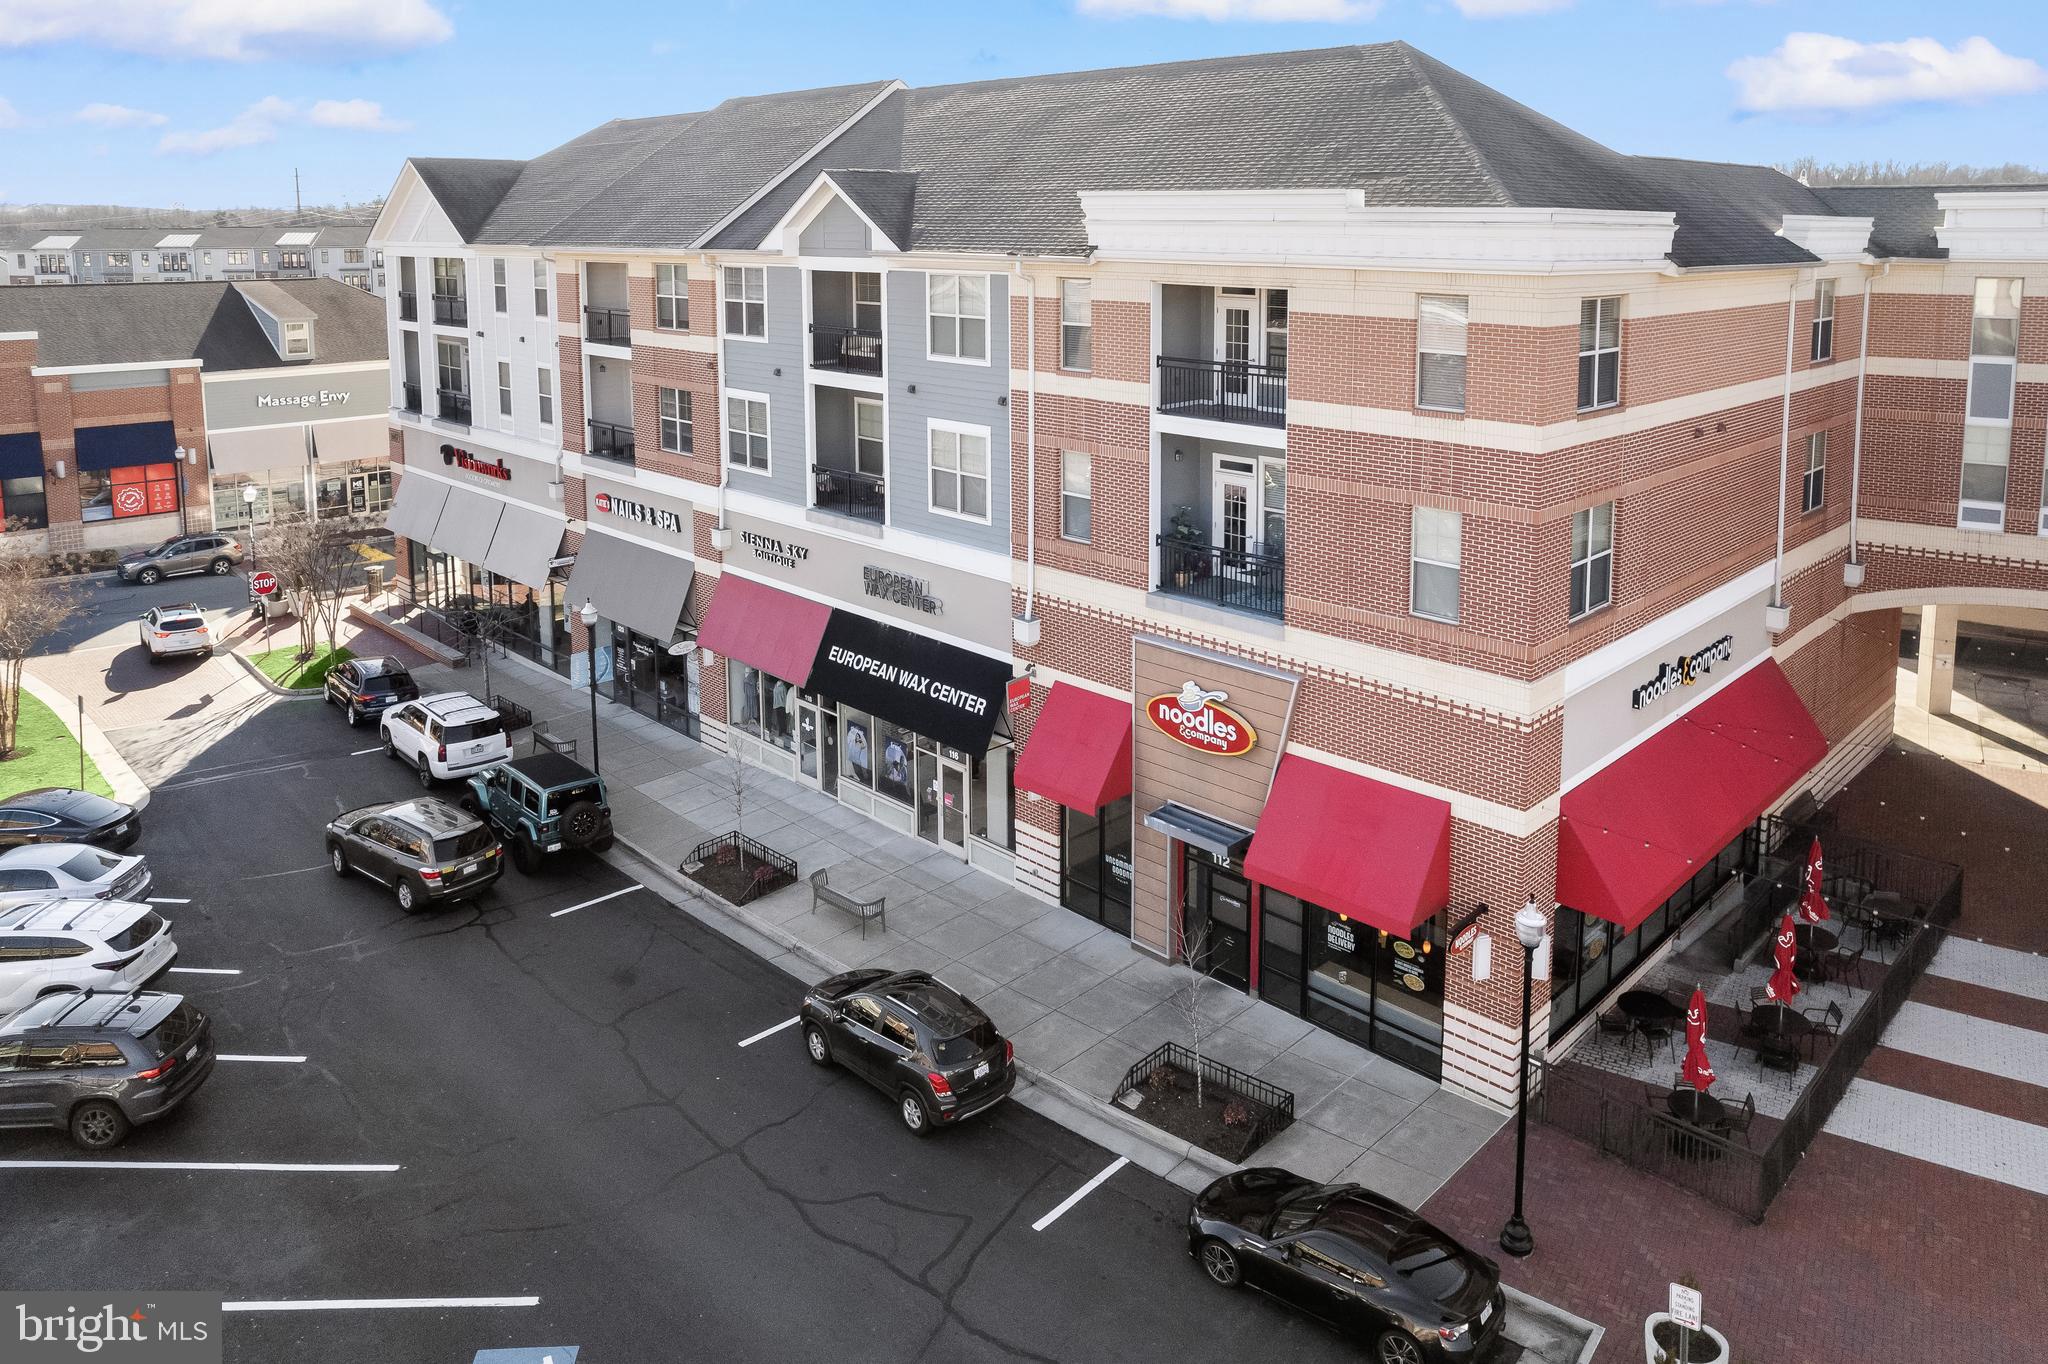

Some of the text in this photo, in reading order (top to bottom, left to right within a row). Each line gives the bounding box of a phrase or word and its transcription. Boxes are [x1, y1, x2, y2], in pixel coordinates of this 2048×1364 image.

[257, 390, 350, 408] Massage Envy
[611, 497, 643, 522] NAILS
[646, 508, 655, 526] &
[657, 510, 680, 533] SPA
[740, 531, 806, 560] SIENNA SKY
[752, 549, 794, 569] BOUTIQUE
[253, 577, 276, 589] STOP
[863, 566, 925, 596] EUROPEAN
[864, 581, 938, 615] WAX CENTER
[828, 645, 987, 716] EUROPEAN WAX CENTER
[1159, 703, 1237, 741] noodles
[1105, 854, 1133, 871] UNCOMMO
[1211, 852, 1231, 869] 112
[1327, 924, 1354, 942] NOODLES
[1327, 933, 1356, 952] DELIVERY
[1455, 925, 1477, 949] NOODLES
